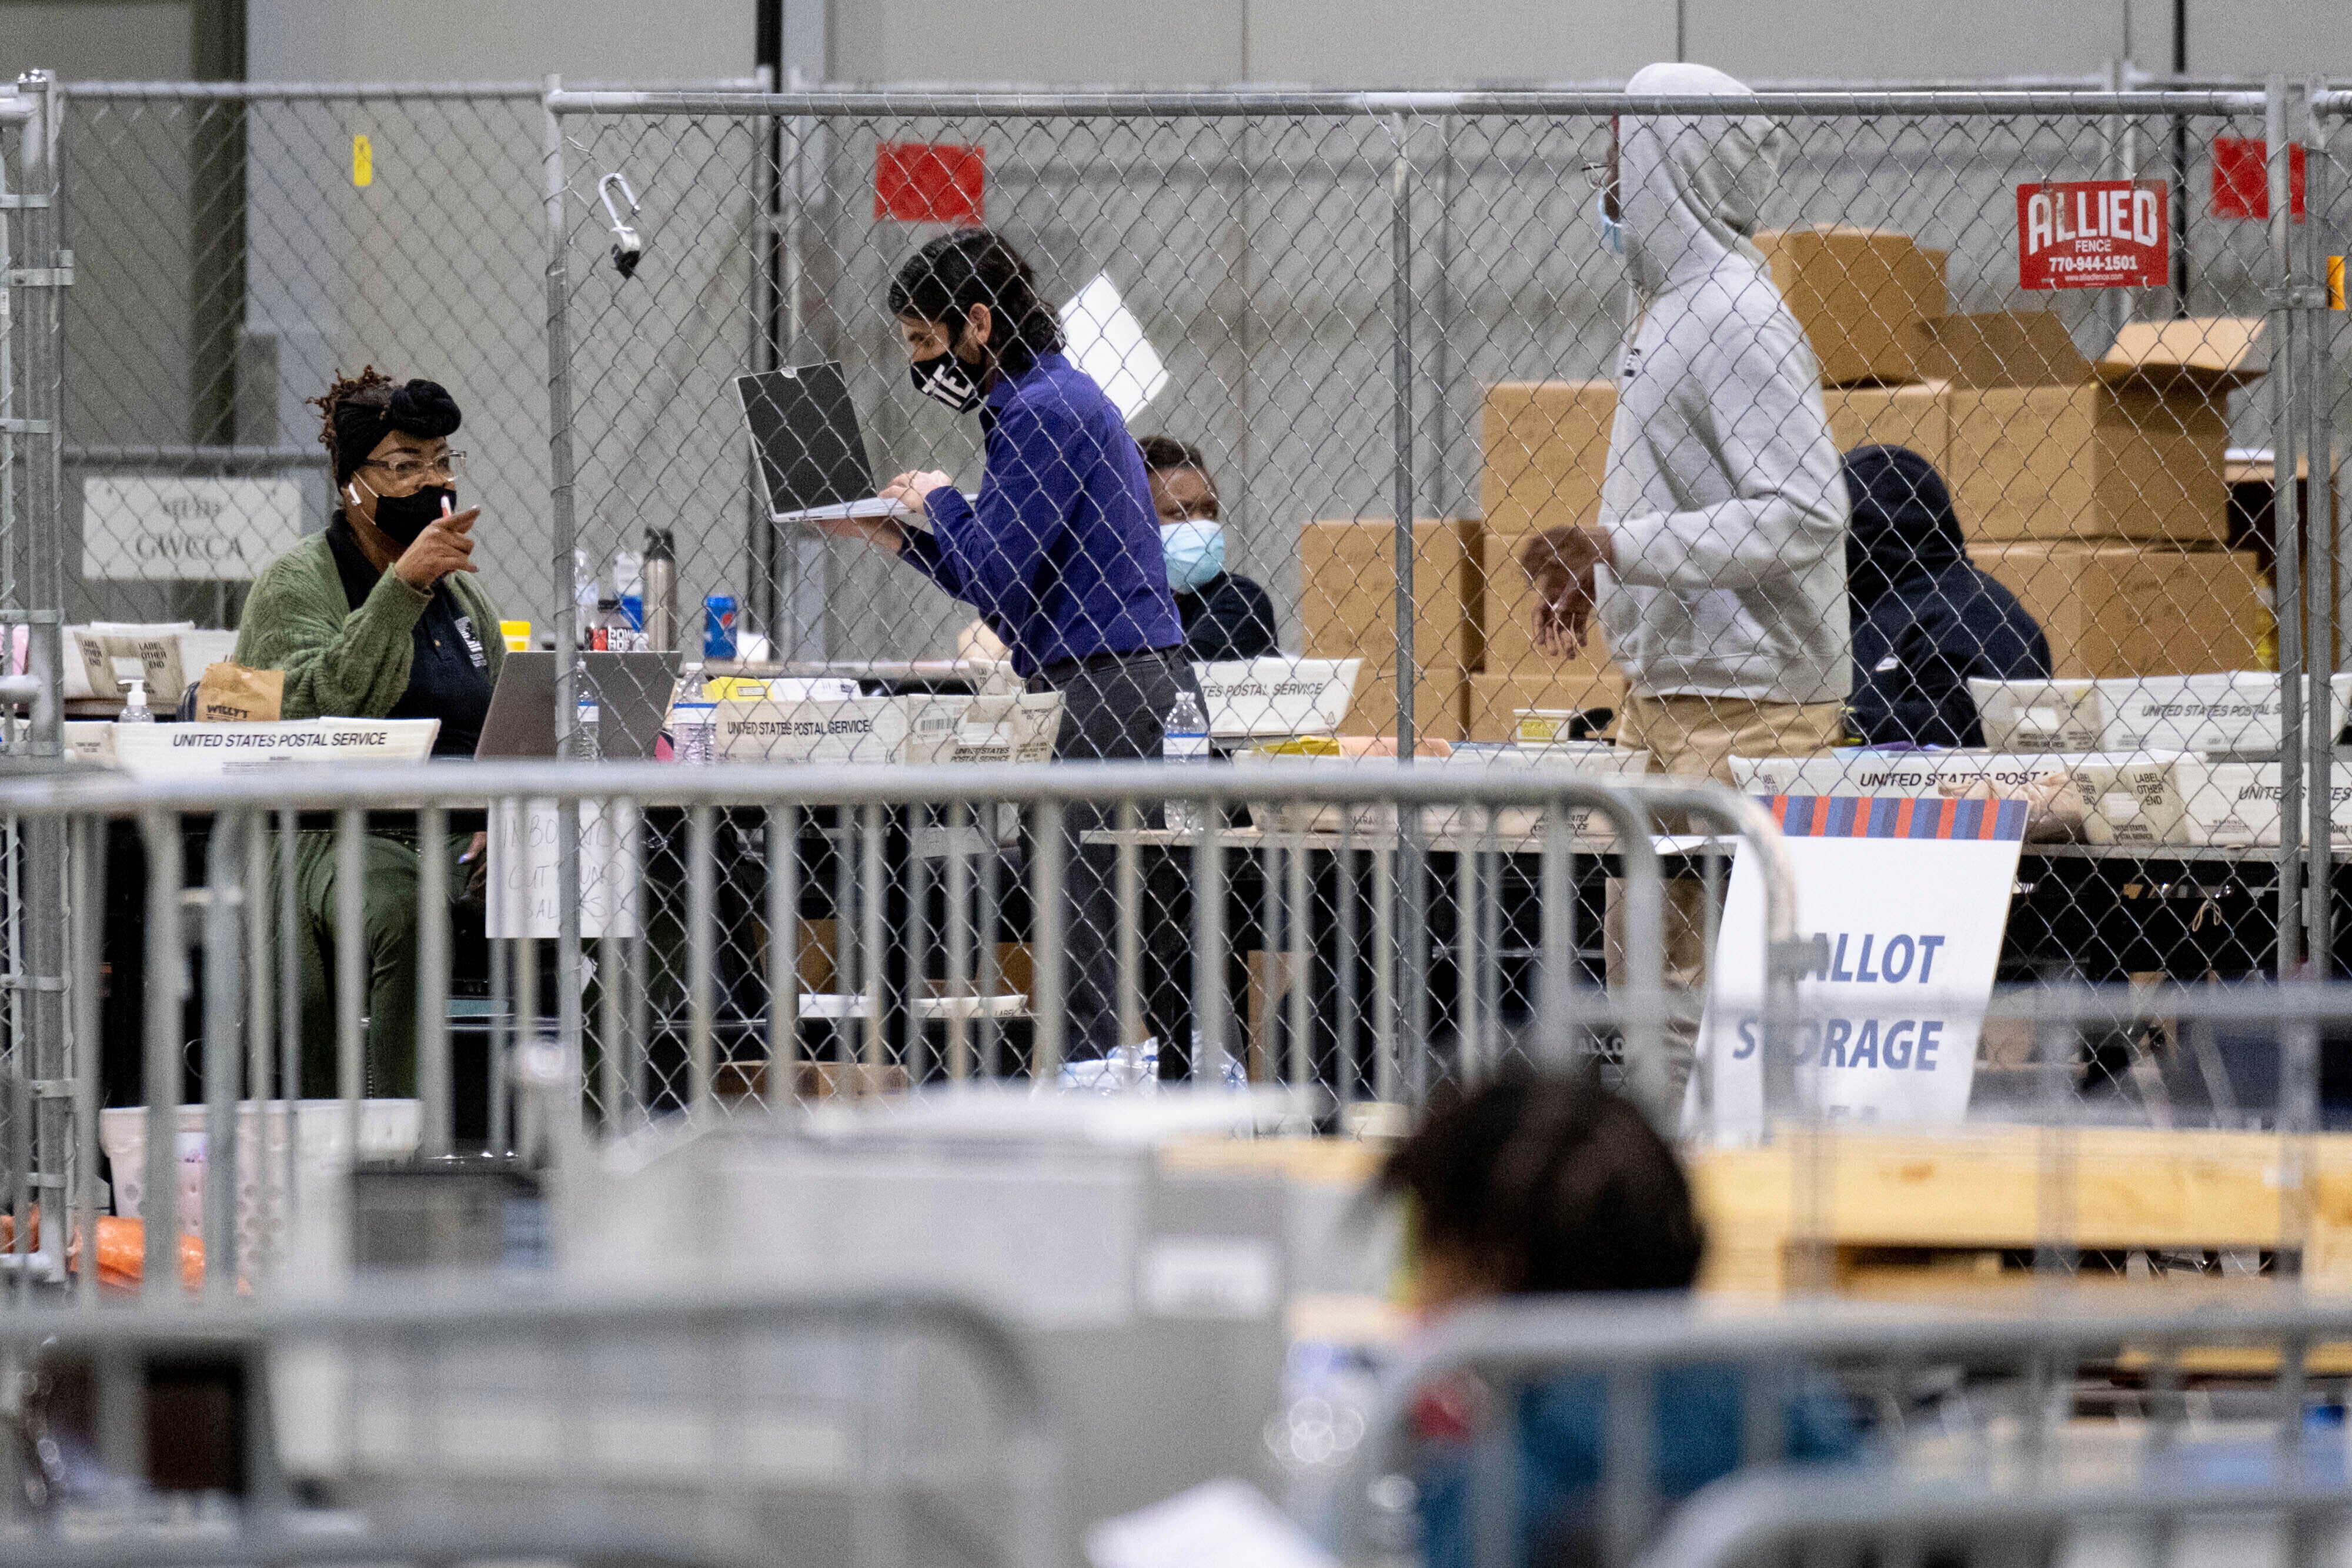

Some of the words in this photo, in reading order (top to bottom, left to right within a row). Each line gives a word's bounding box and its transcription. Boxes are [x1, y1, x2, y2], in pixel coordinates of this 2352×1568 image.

[2029, 190, 2158, 255] ALLIED
[2075, 239, 2112, 253] FENCE
[2049, 255, 2138, 272] 770-944-1501
[138, 641, 164, 651] LABEL
[141, 651, 167, 660] OTHER
[1226, 684, 1268, 696] POSTAL
[1273, 683, 1322, 696] SERVICE
[2141, 704, 2181, 716] UNITED
[2185, 705, 2228, 716] STATES
[727, 721, 757, 734] UNITED
[759, 721, 792, 735] STATES
[794, 721, 825, 734] POSTAL
[827, 719, 870, 734] SERVICE
[173, 734, 223, 747] UNITED
[225, 734, 276, 747] STATES
[278, 734, 328, 746] POSTAL
[331, 733, 387, 745] SERVICE
[1860, 773, 1921, 787] UNITED
[2075, 773, 2093, 783] ABEL
[2133, 773, 2161, 783] LABEL
[2137, 784, 2164, 794] OTHER
[2239, 786, 2282, 800] UNITE
[2146, 796, 2163, 805] END
[1776, 931, 1946, 984] ALLOT
[1732, 1015, 1944, 1071] SORAGE
